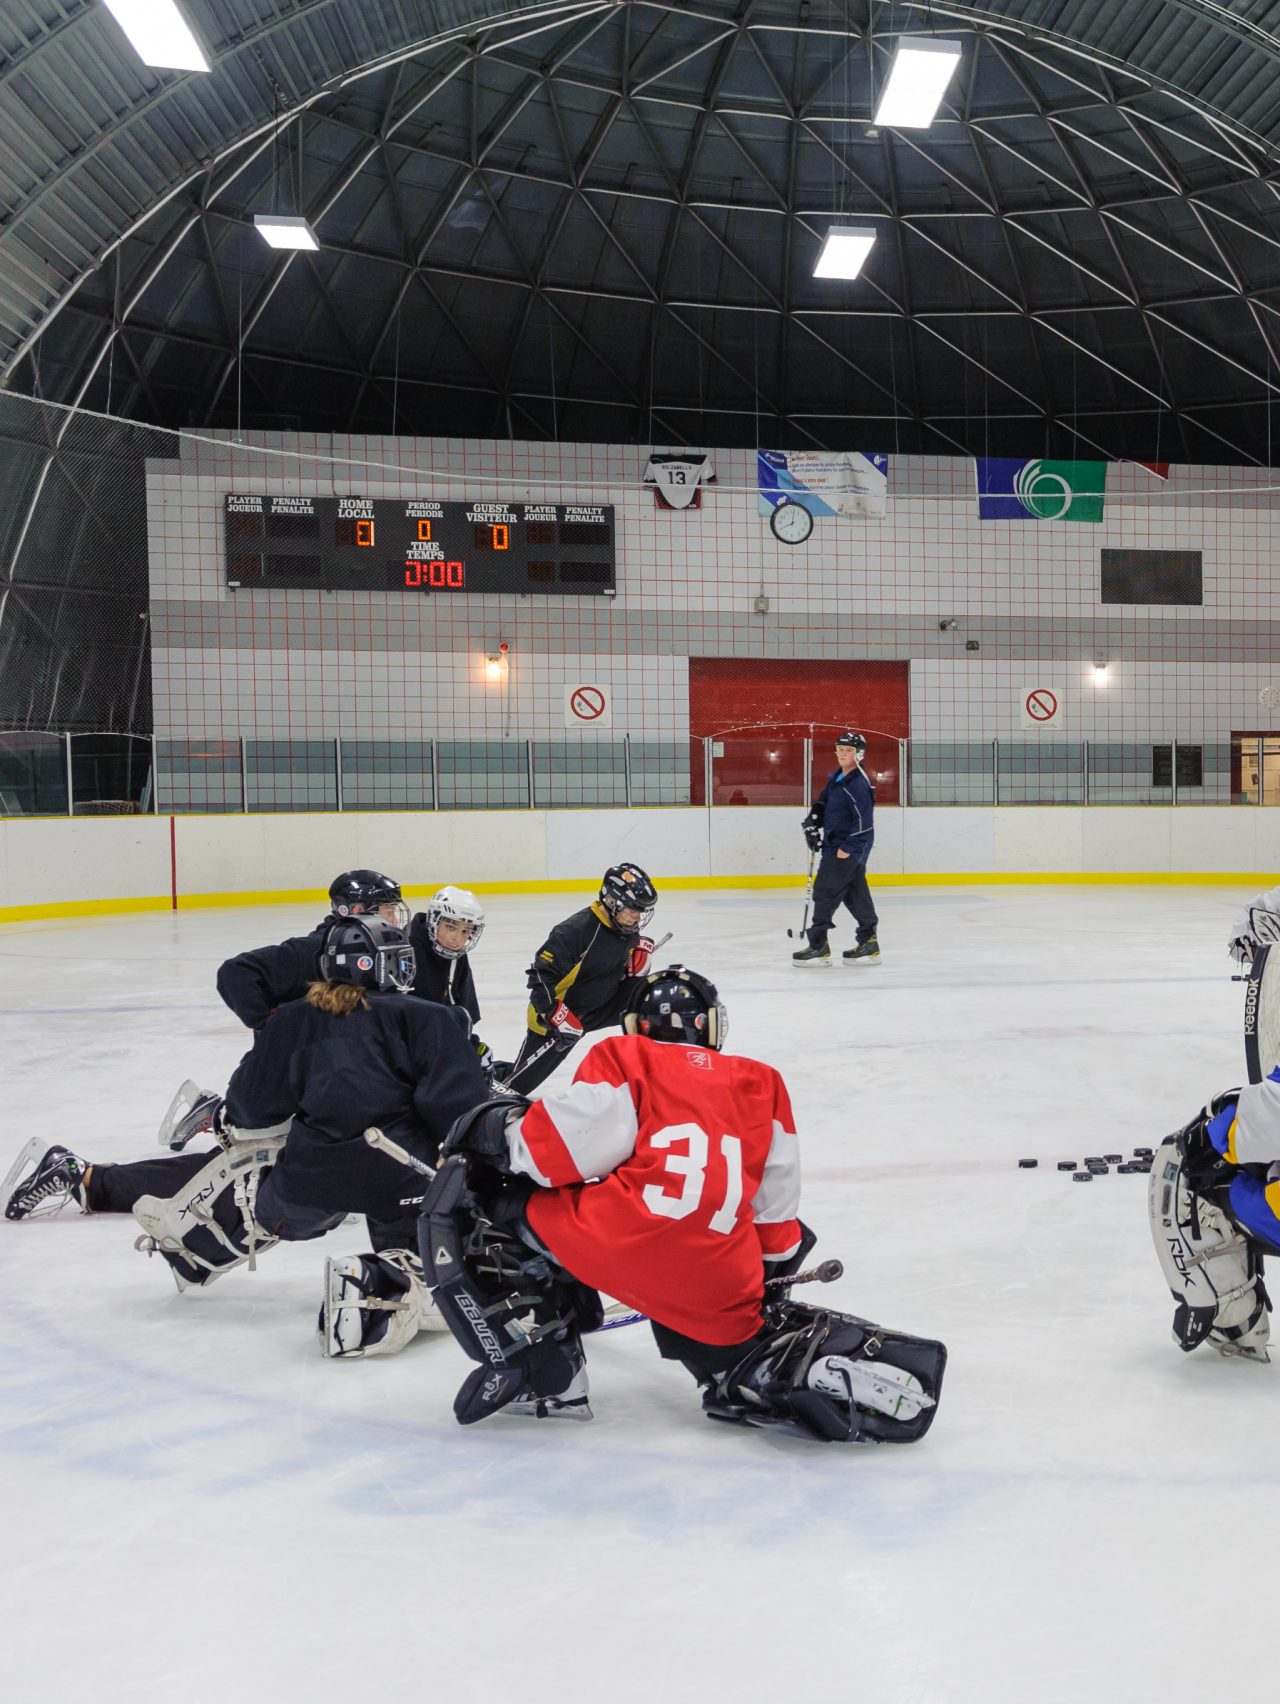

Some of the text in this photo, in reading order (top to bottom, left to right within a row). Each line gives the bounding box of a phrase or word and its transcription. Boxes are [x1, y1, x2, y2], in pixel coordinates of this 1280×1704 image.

[668, 471, 686, 485] 13
[228, 496, 263, 505] PLAYER
[272, 497, 312, 506] PENALTY
[339, 499, 374, 510] HOME
[227, 504, 263, 513] JOUEUR
[271, 505, 314, 514] PENALITE
[408, 501, 441, 510] PERIOD
[473, 503, 510, 513] GUEST
[524, 505, 557, 514] PLAYER
[338, 509, 375, 519] LOCAL
[405, 510, 444, 518] PERIODE
[566, 507, 603, 515] PENALTY
[466, 512, 518, 523] VISITEUR
[523, 513, 558, 522] JOUEUR
[565, 514, 605, 523] PENALITE
[417, 519, 432, 541] 0
[493, 524, 509, 550] 0
[410, 541, 440, 551] TIME
[406, 550, 445, 560] TEMPS
[641, 1122, 744, 1236] 31
